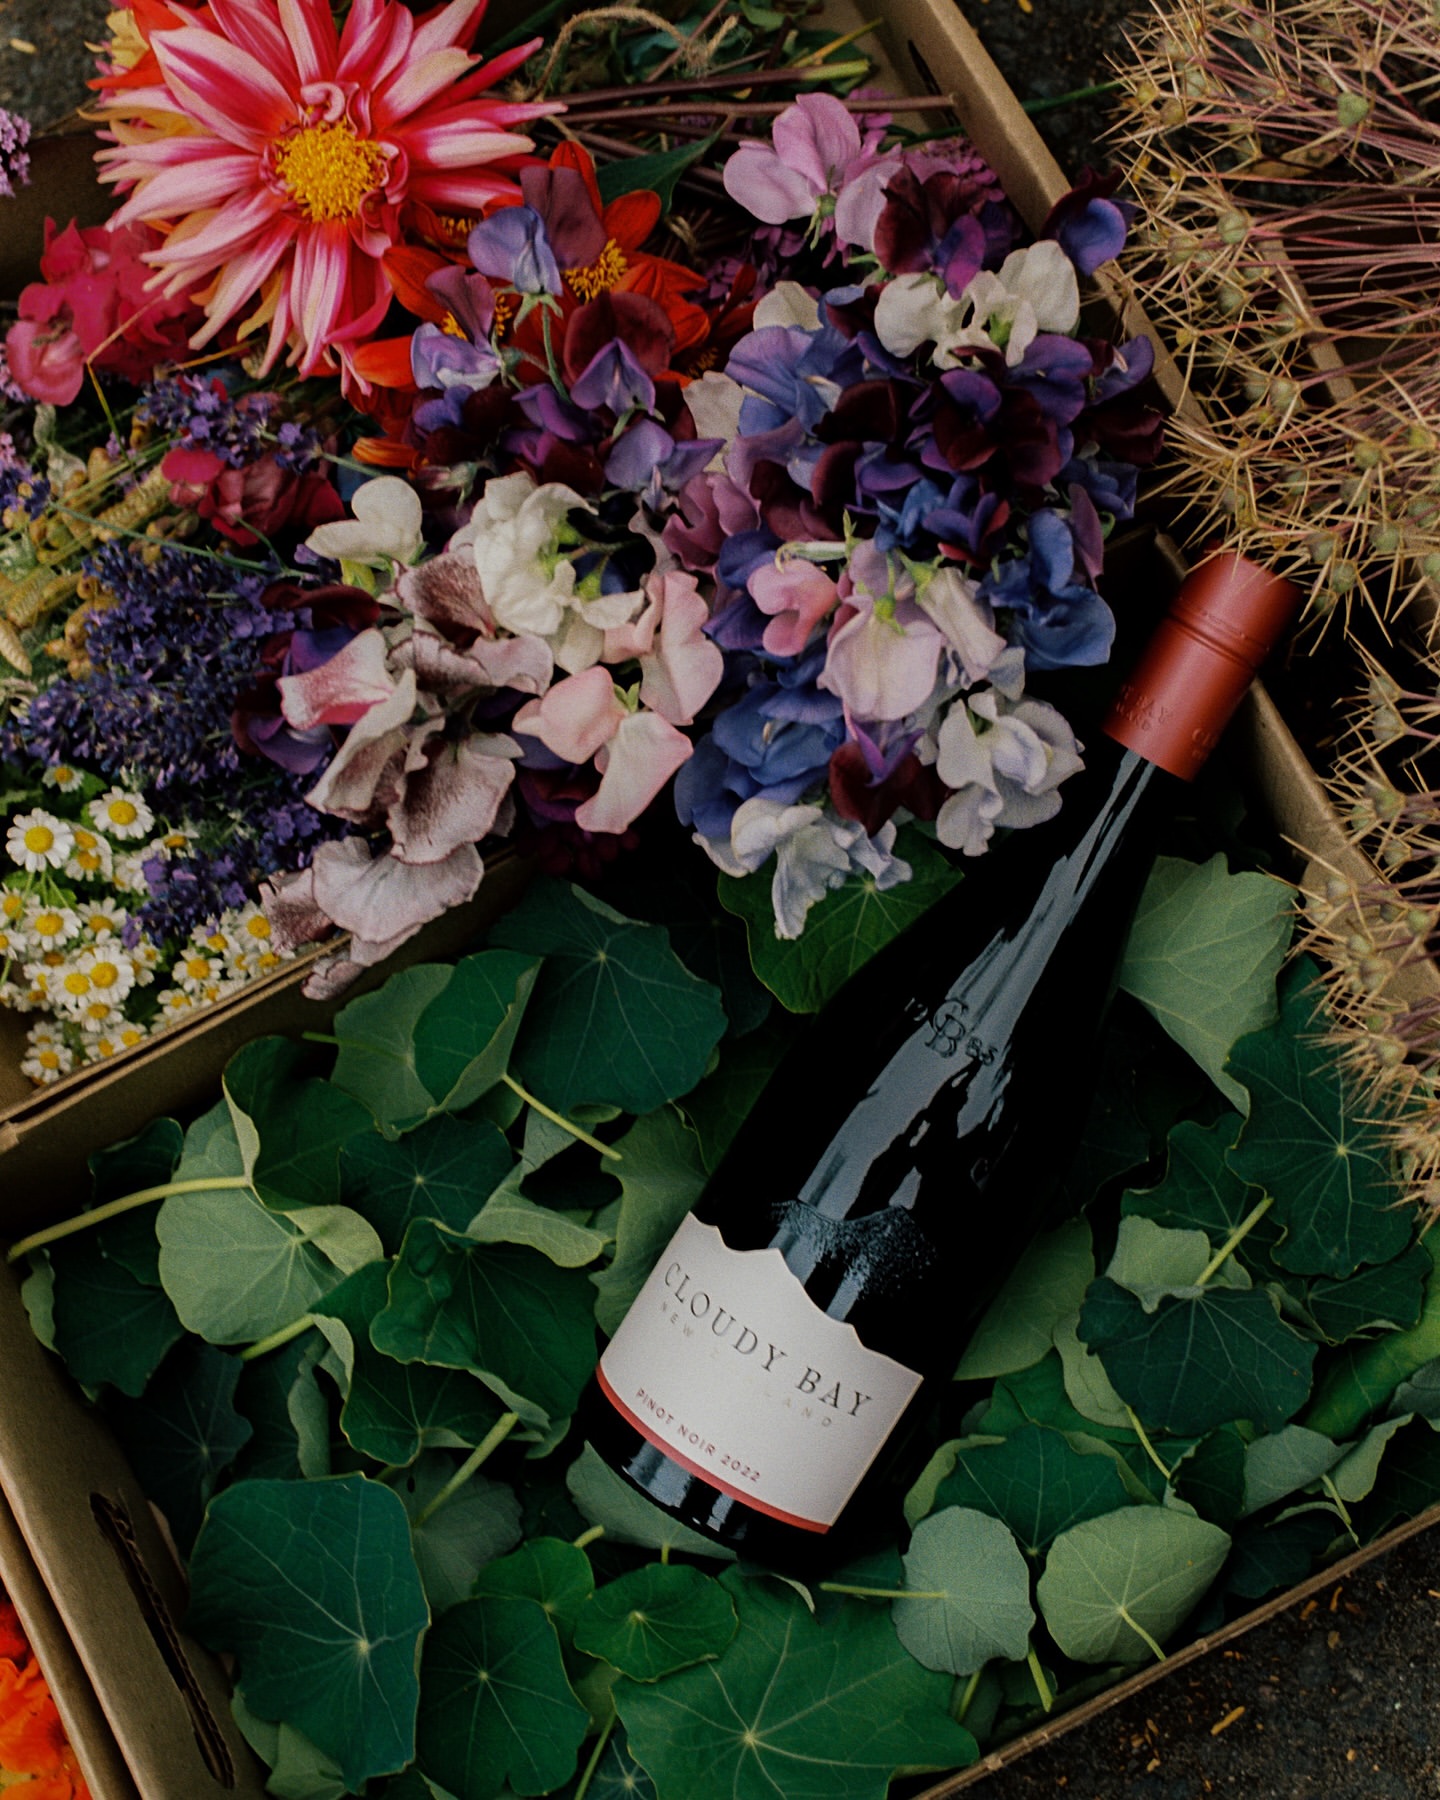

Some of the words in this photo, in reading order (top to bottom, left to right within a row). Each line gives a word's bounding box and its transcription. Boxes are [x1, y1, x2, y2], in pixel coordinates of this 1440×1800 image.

[662, 1302, 694, 1338] NEW
[664, 1262, 788, 1372] CLOUDY
[795, 1367, 873, 1417] BAY
[636, 1388, 675, 1426] PINOT
[677, 1424, 716, 1456] NOIR
[720, 1455, 762, 1482] 2022
